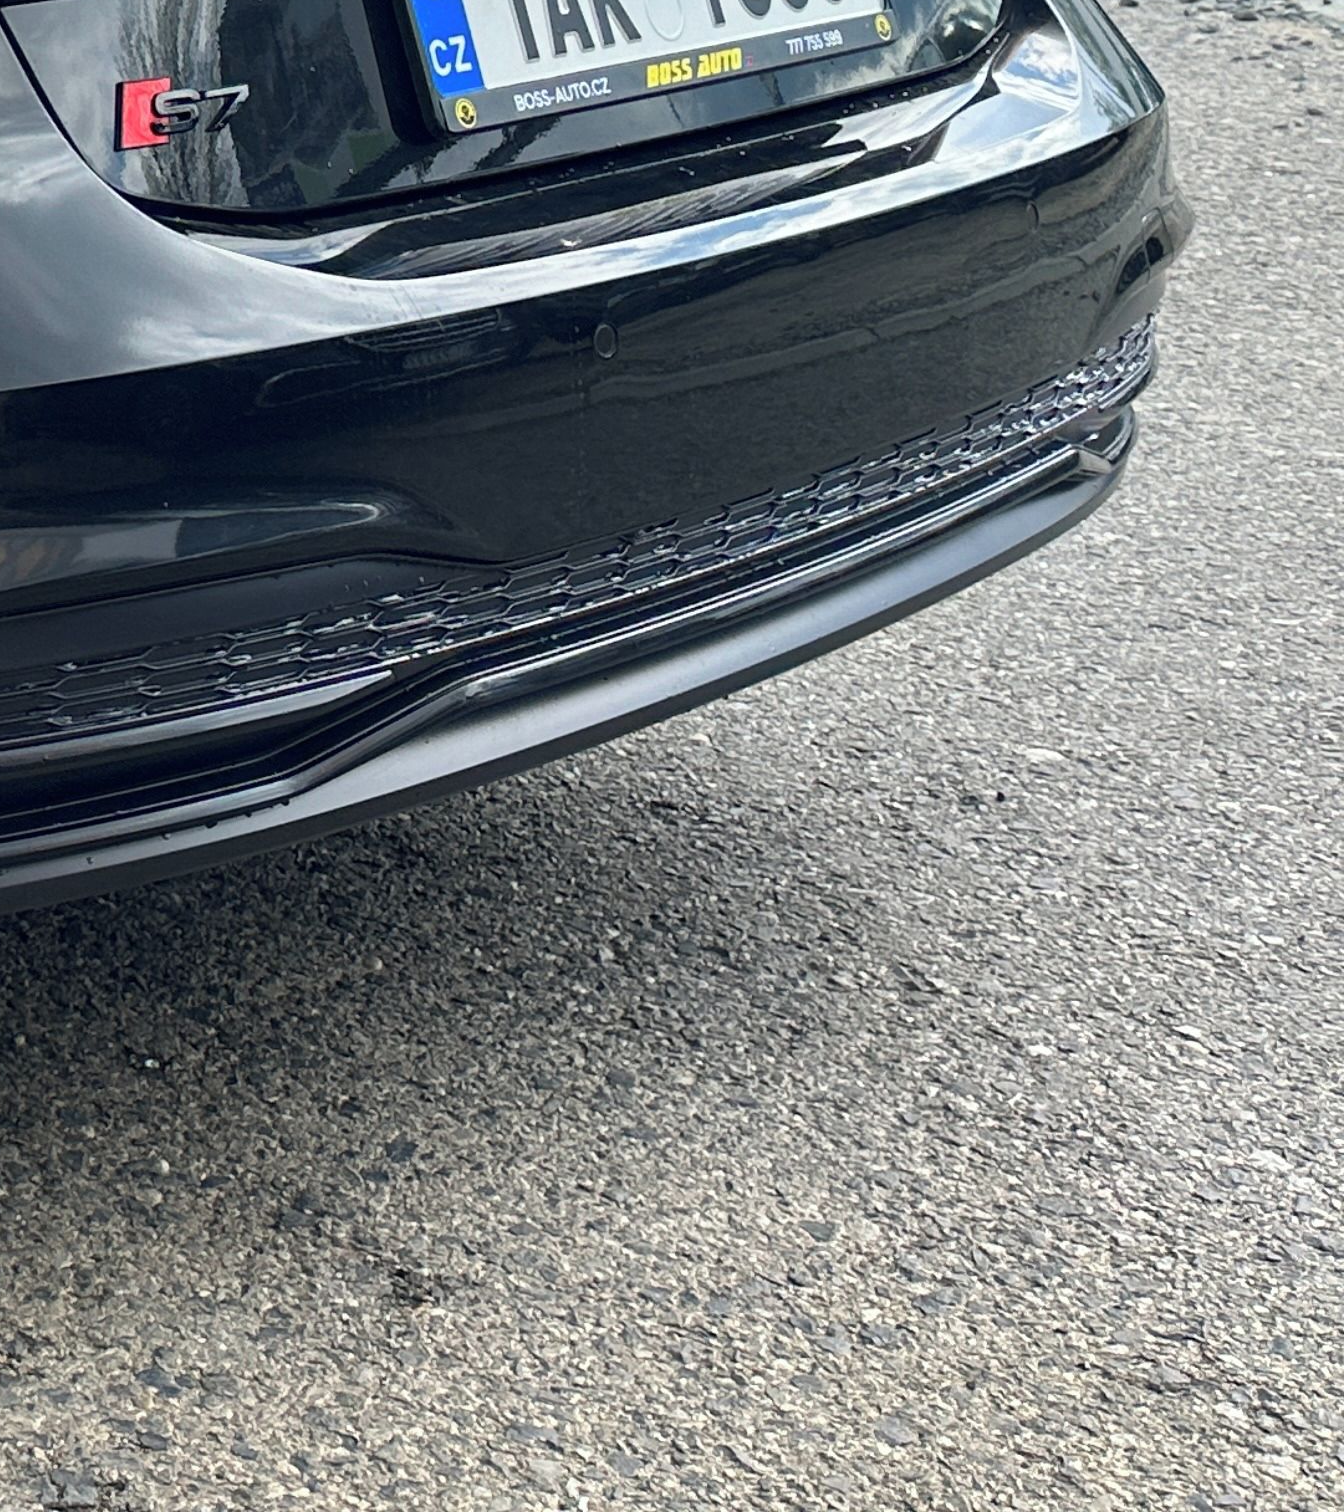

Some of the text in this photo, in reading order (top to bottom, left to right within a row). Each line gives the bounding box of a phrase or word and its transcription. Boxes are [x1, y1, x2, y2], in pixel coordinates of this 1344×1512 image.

[428, 34, 473, 77] CZ
[645, 47, 743, 89] BOSS AUTO
[150, 83, 250, 136] S7
[513, 76, 612, 112] BOSS-AUTO.CZ
